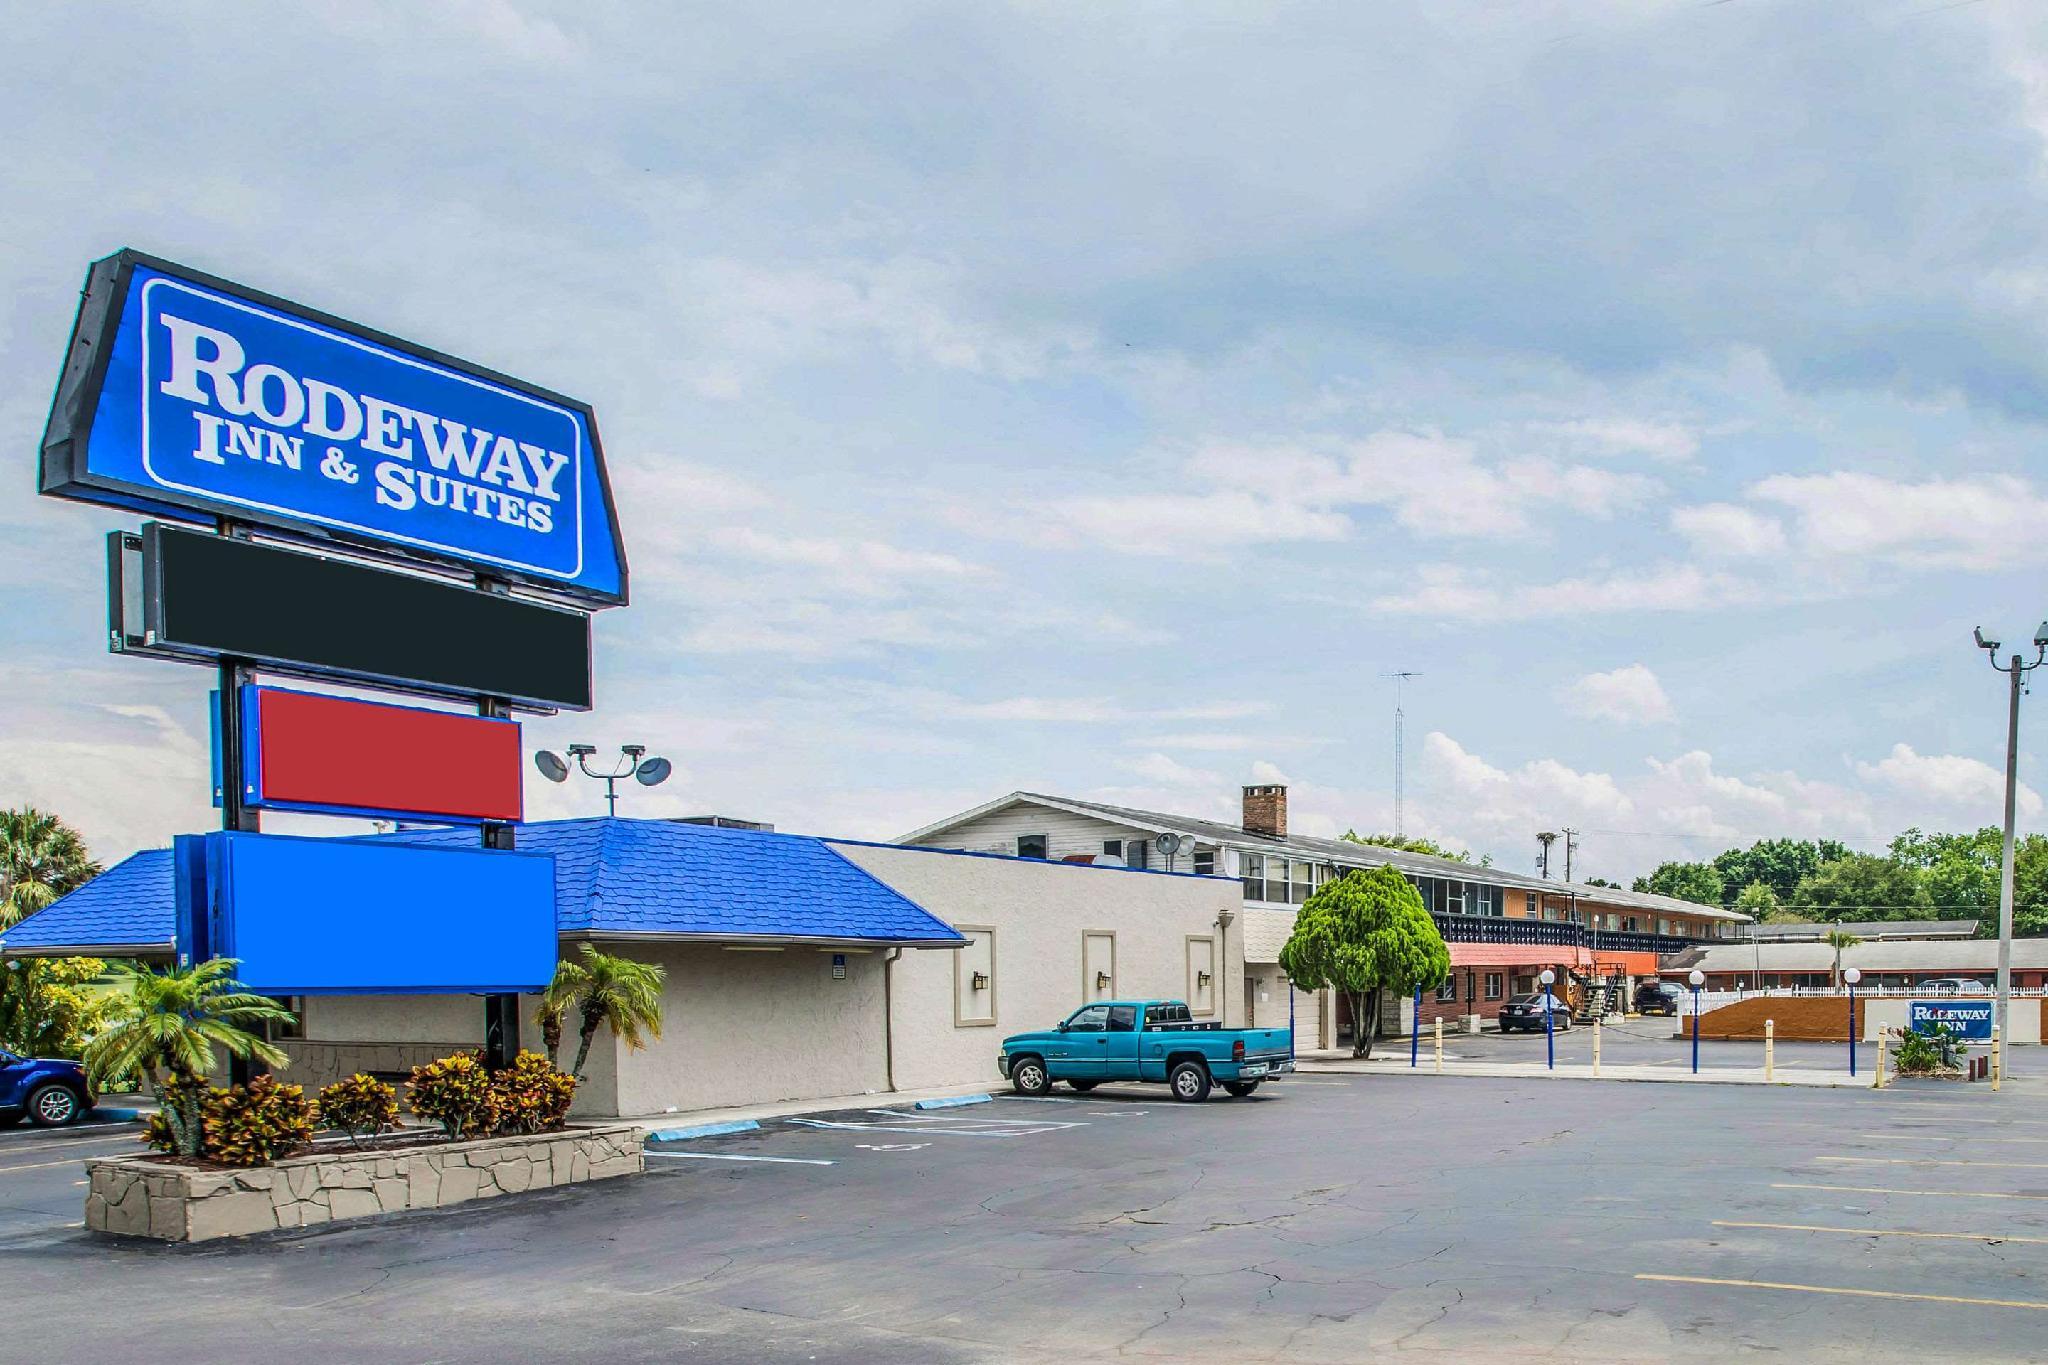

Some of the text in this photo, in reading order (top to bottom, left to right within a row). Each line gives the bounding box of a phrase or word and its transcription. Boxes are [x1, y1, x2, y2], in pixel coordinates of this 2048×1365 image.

[161, 313, 568, 502] RODEWAY
[193, 412, 553, 533] INN & SUITES
